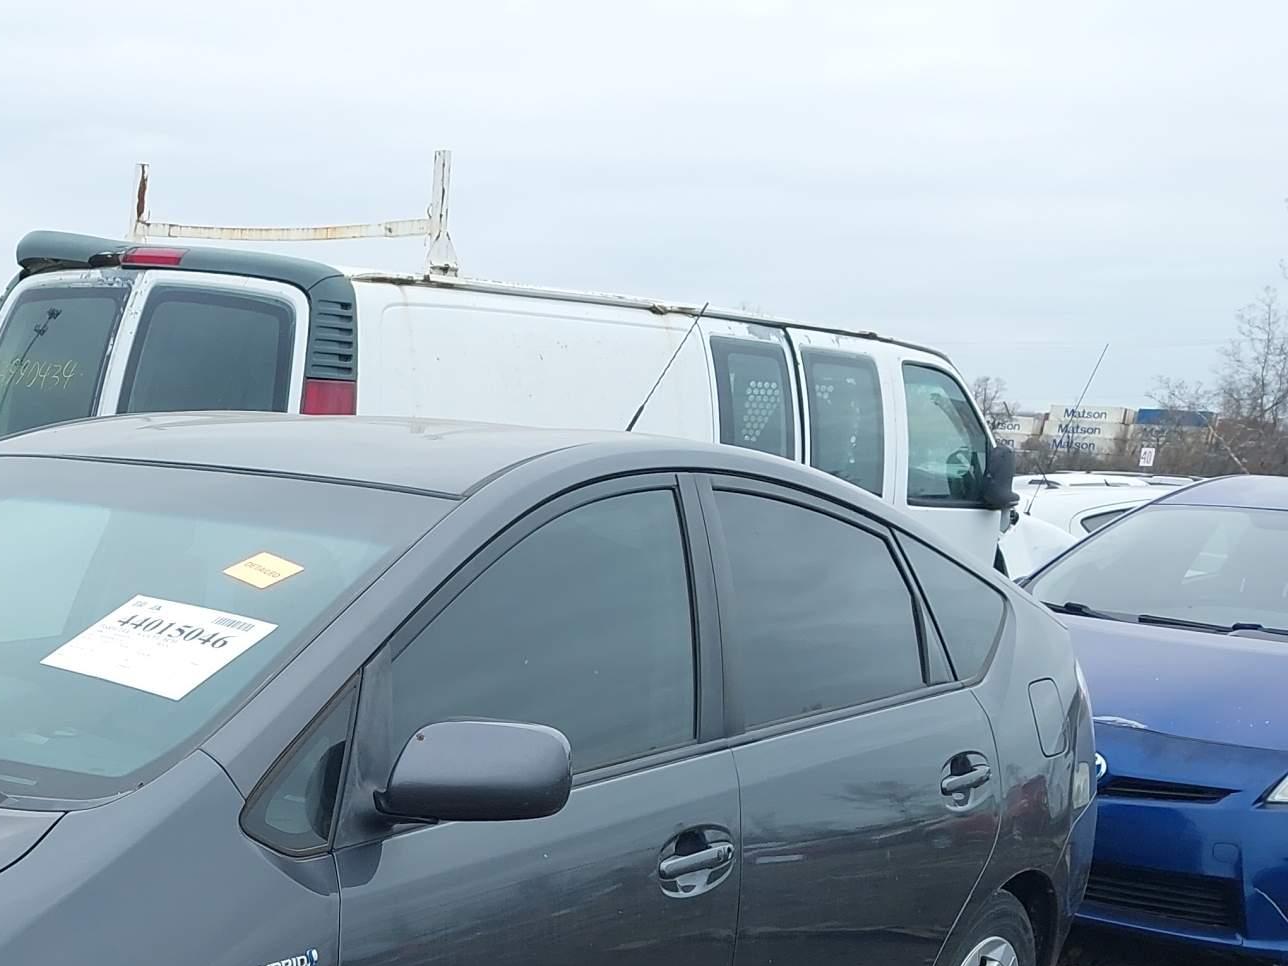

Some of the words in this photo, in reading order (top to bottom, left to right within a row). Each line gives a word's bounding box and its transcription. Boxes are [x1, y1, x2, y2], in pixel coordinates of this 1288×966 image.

[1063, 408, 1107, 420] Matson
[1057, 423, 1102, 435] Matson
[117, 614, 240, 649] 44015046
